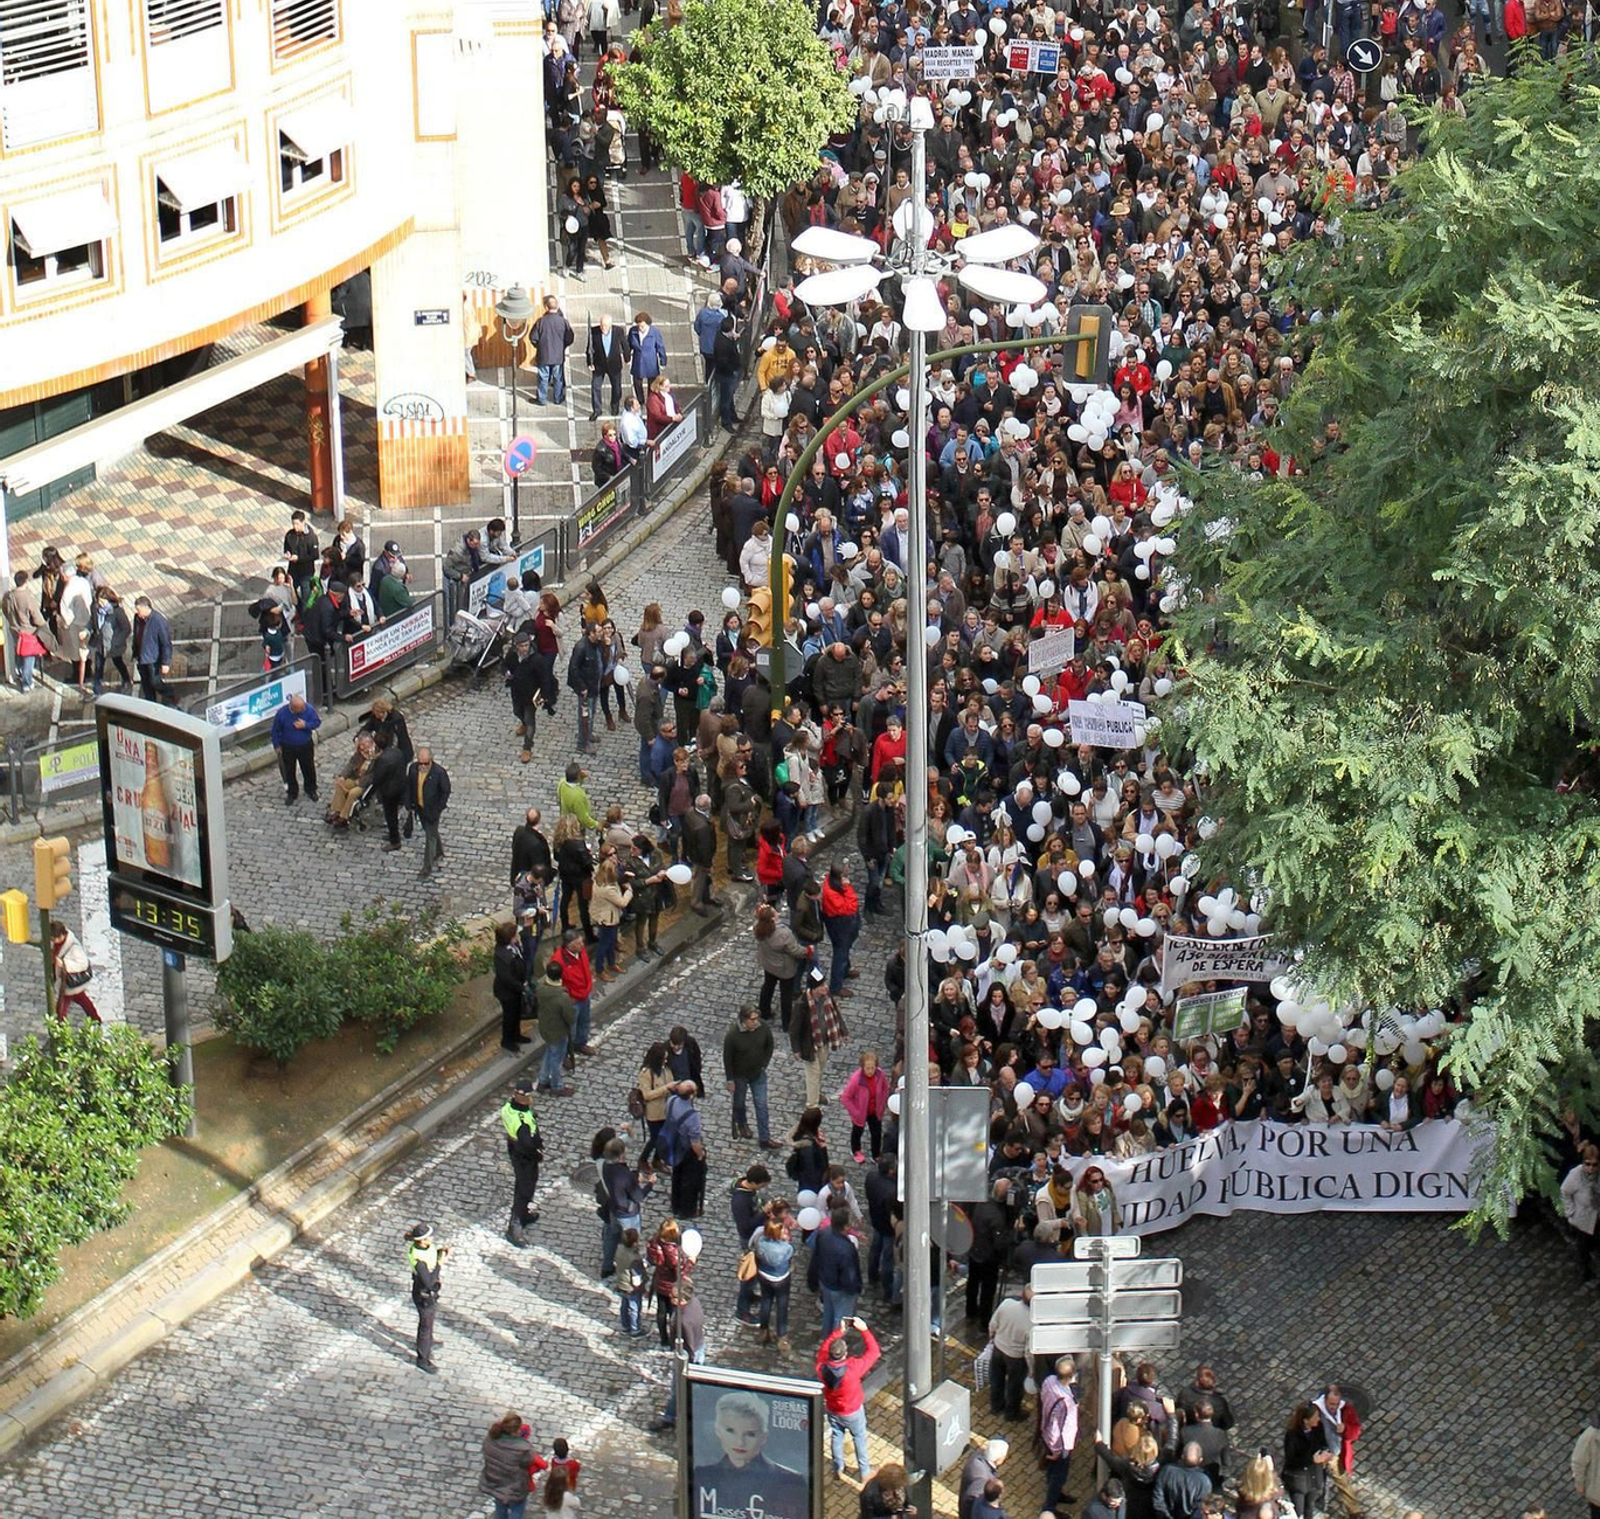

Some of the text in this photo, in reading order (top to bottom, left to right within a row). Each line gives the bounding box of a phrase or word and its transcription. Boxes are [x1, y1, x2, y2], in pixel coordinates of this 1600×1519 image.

[136, 900, 200, 939] 13:35
[1192, 959, 1264, 973] DE ESPERA
[1127, 1123, 1420, 1184] HUELVA, POR UNA
[772, 1414, 802, 1431] LOOK
